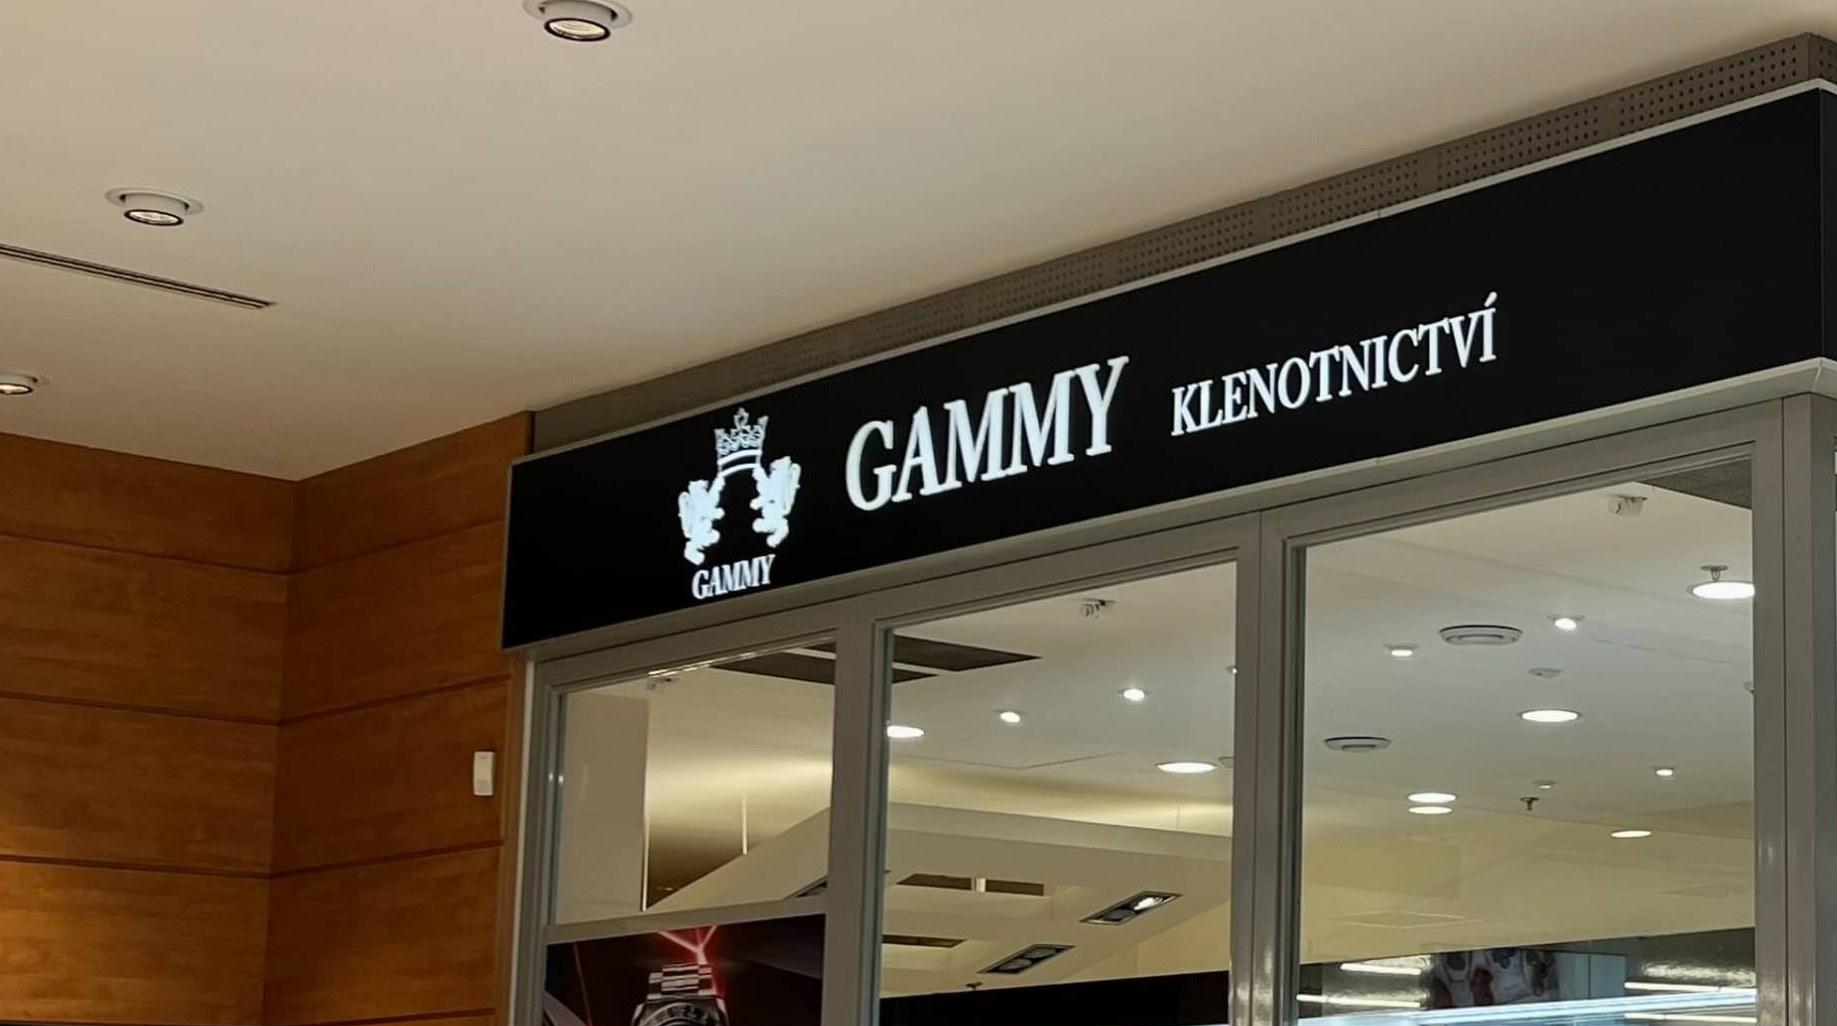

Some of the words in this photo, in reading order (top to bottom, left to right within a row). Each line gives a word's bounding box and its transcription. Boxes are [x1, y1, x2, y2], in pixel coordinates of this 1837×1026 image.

[845, 356, 1130, 512] GAMMY
[1170, 291, 1499, 437] KLENOTNICTVÍ
[692, 554, 776, 600] GAMMY
